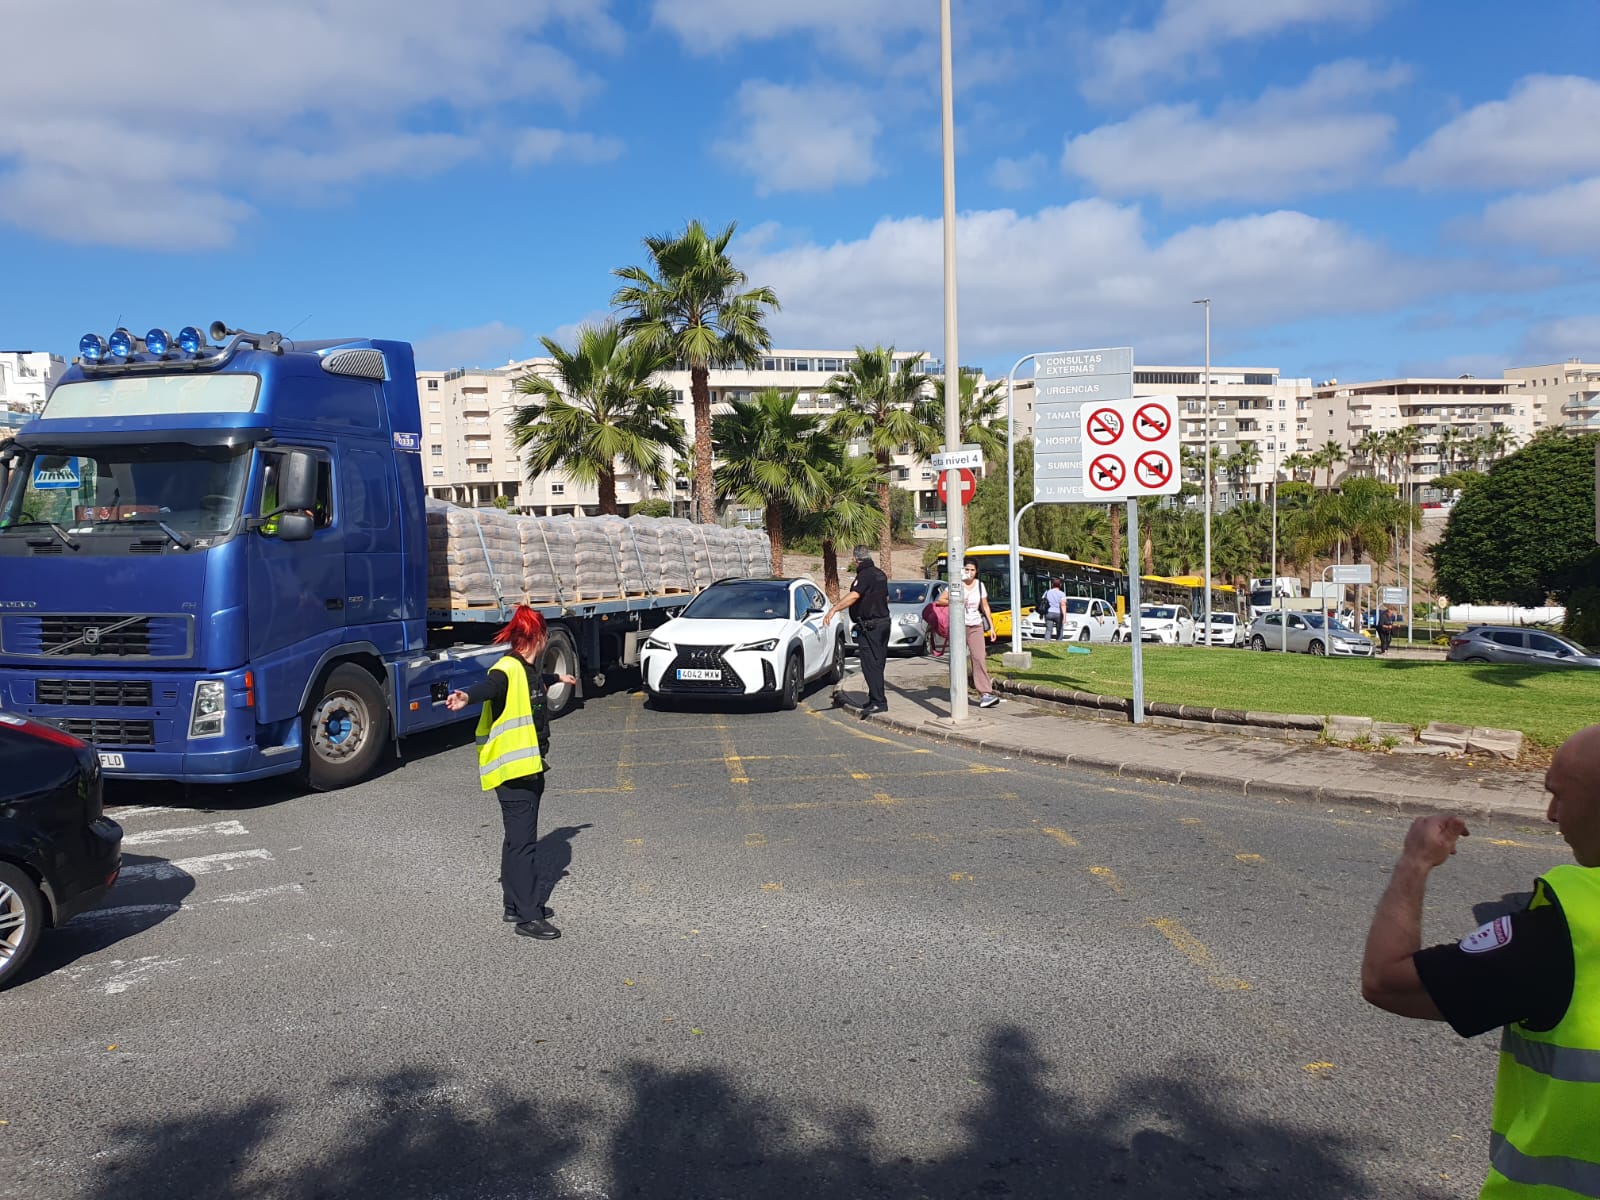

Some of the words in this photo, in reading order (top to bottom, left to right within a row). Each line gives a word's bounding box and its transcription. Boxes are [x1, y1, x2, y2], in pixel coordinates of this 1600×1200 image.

[1046, 354, 1102, 366] CONSULTAS
[1046, 365, 1095, 375] EXTERNAS
[1046, 385, 1100, 394] URGENCIAS
[946, 456, 970, 464] nivel
[972, 454, 978, 462] 4
[682, 670, 702, 679] 4042
